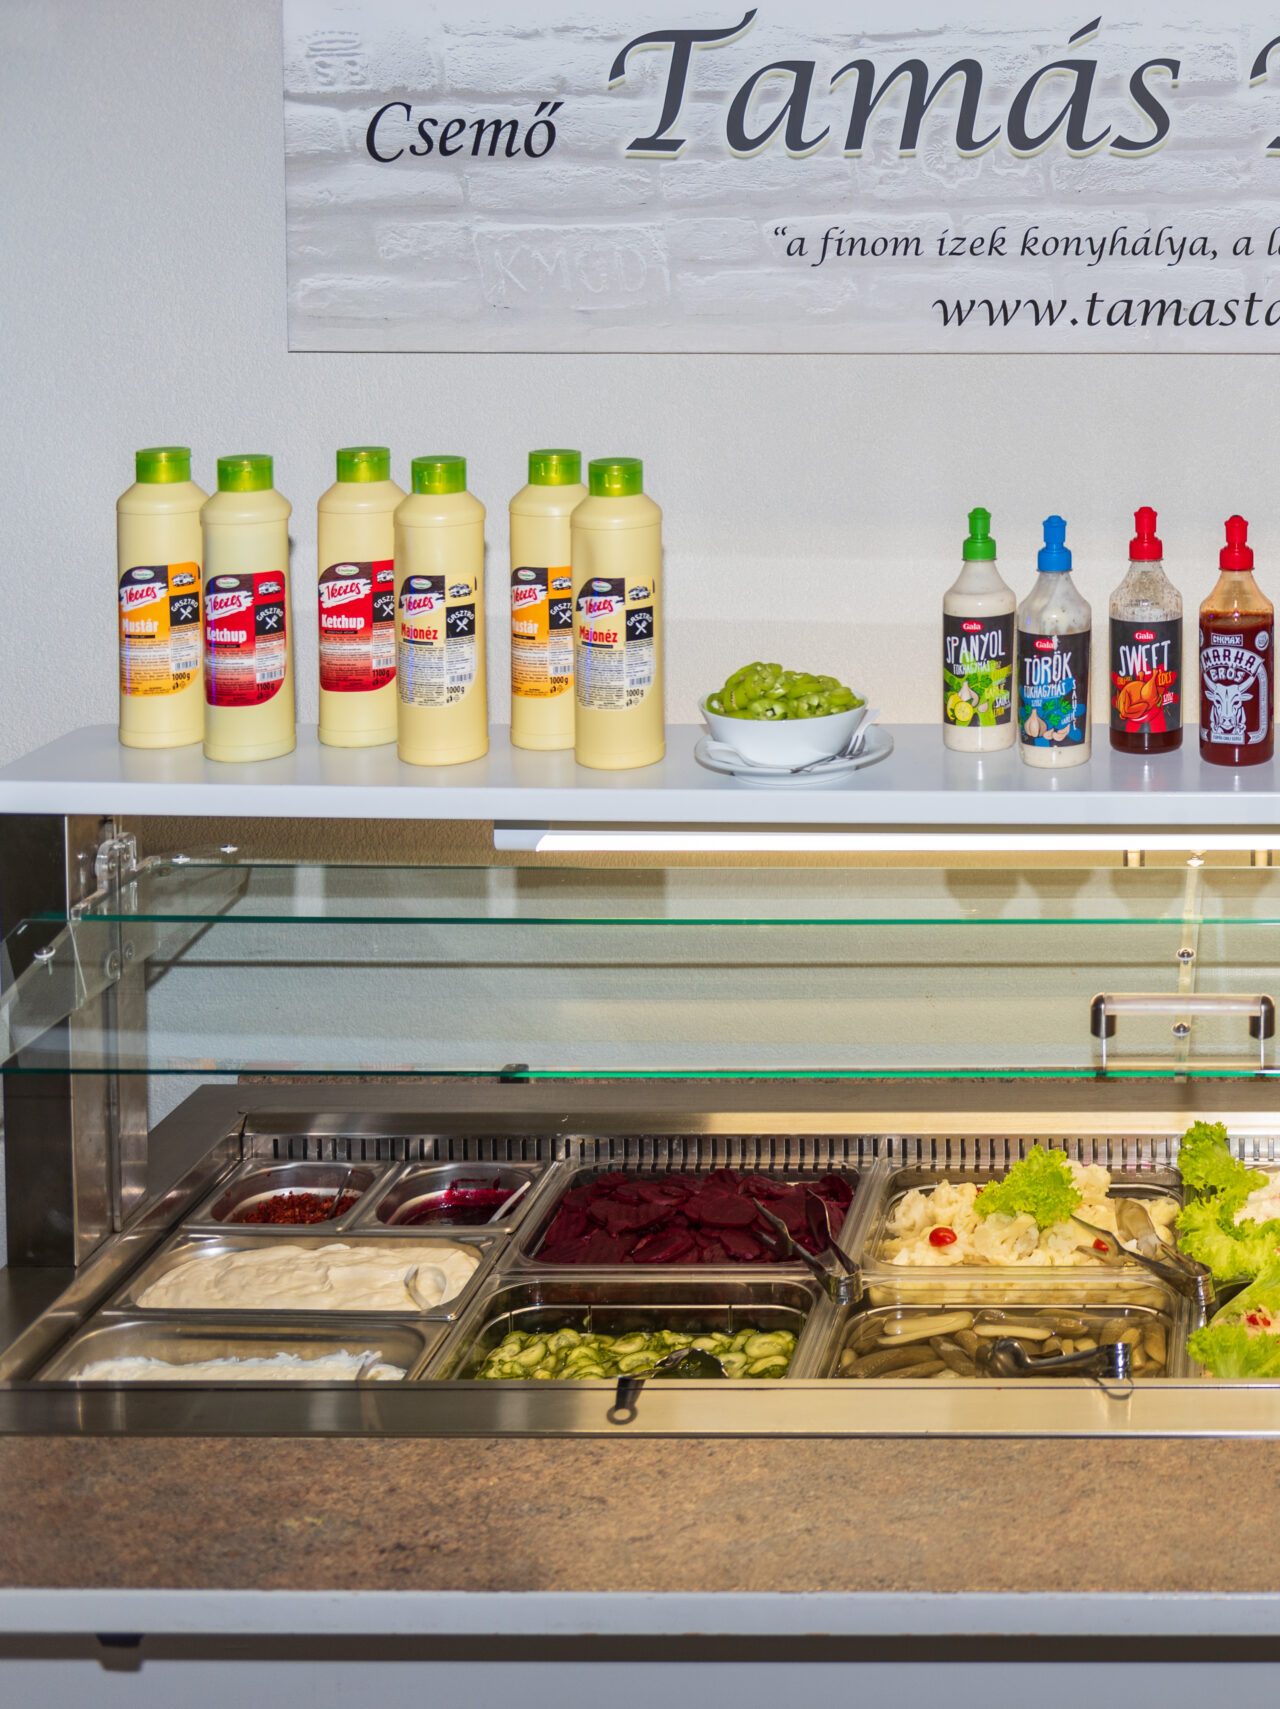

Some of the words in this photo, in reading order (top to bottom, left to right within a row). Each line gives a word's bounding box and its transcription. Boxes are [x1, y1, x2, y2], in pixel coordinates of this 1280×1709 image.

[609, 9, 1181, 159] Tamás
[366, 102, 565, 163] Csemő
[1020, 226, 1218, 267] konyhálya,
[1232, 237, 1255, 256] a
[122, 618, 159, 633] Mustár
[322, 614, 365, 630] Ketchup
[963, 623, 981, 631] Gala
[207, 627, 247, 644] Ketchup
[401, 622, 438, 640] Majonéz
[580, 625, 618, 643] Majonéz
[1135, 632, 1154, 640] Gala
[946, 630, 1006, 665] SPANYOL
[1118, 640, 1171, 678] SWEET
[1203, 648, 1257, 669] MARHA
[172, 672, 186, 681] 1000
[1024, 651, 1073, 685] TÖRÖK
[446, 685, 460, 694] 1000
[550, 677, 564, 685] 1000
[626, 688, 639, 697] 1000
